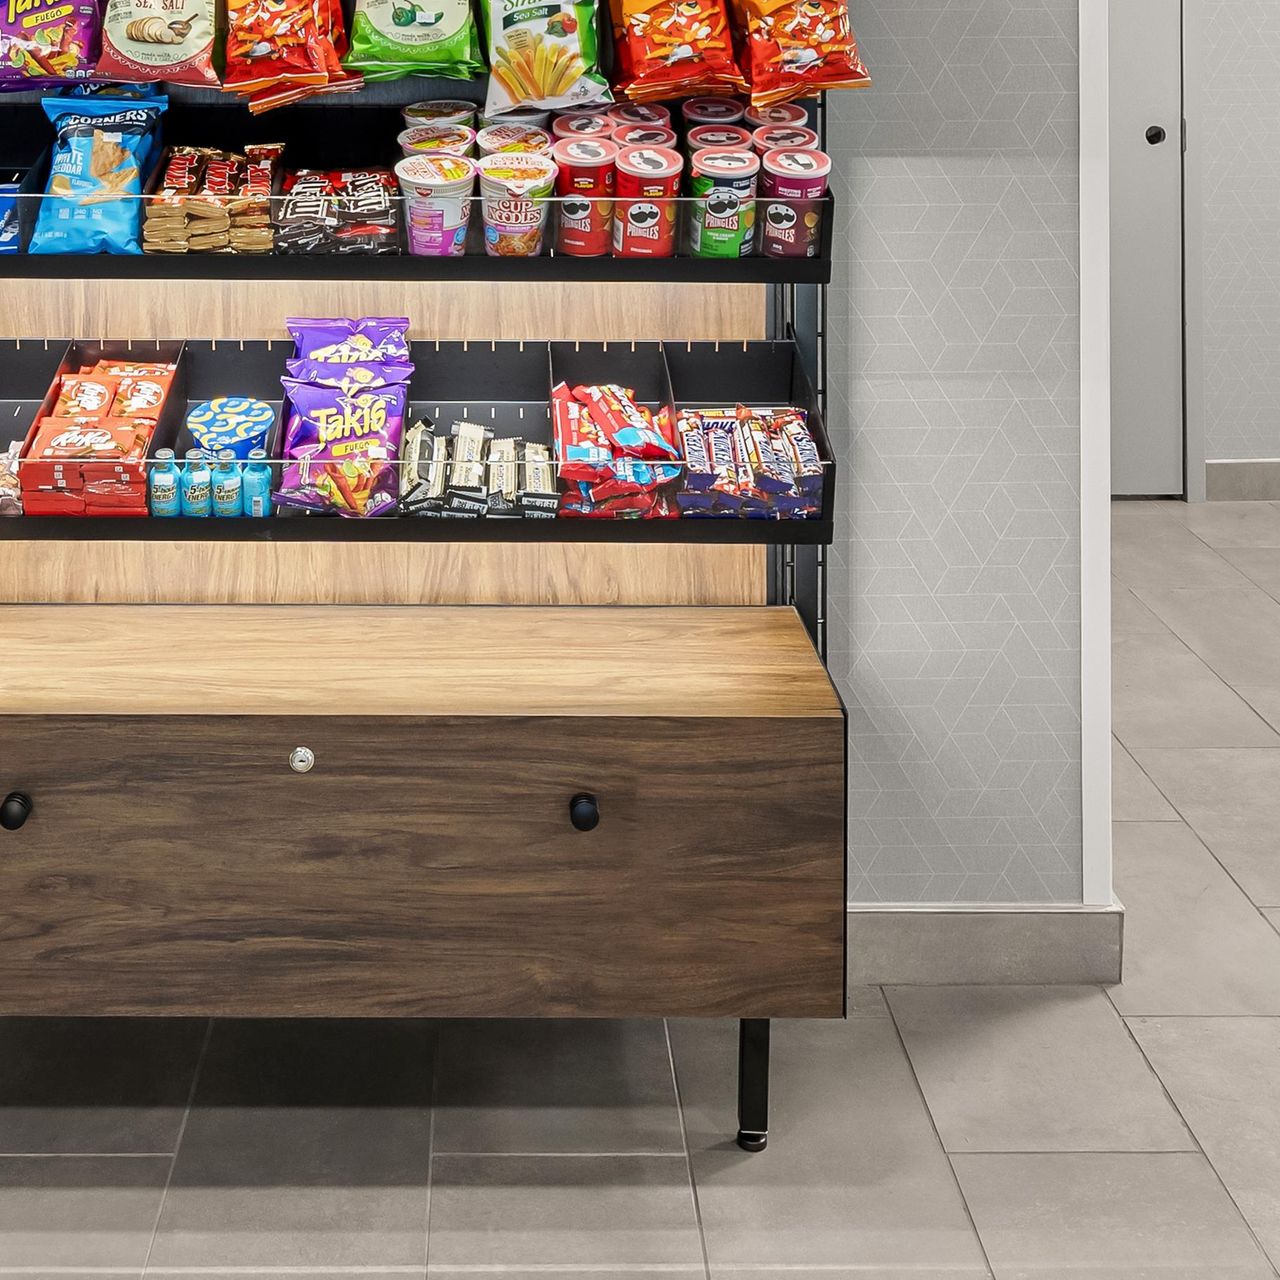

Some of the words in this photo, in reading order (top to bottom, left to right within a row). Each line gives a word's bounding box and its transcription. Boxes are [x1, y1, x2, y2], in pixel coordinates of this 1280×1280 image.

[35, 9, 63, 24] FUEGO
[513, 12, 530, 21] Sea
[532, 7, 548, 16] Salt
[498, 199, 533, 212] CUP
[488, 207, 541, 224] NOODLES
[705, 213, 738, 229] PRINGLES
[561, 216, 591, 232] PRINGLES
[627, 222, 659, 240] PRINGLES
[765, 222, 795, 242] PRINGLES
[311, 399, 386, 442] Takis
